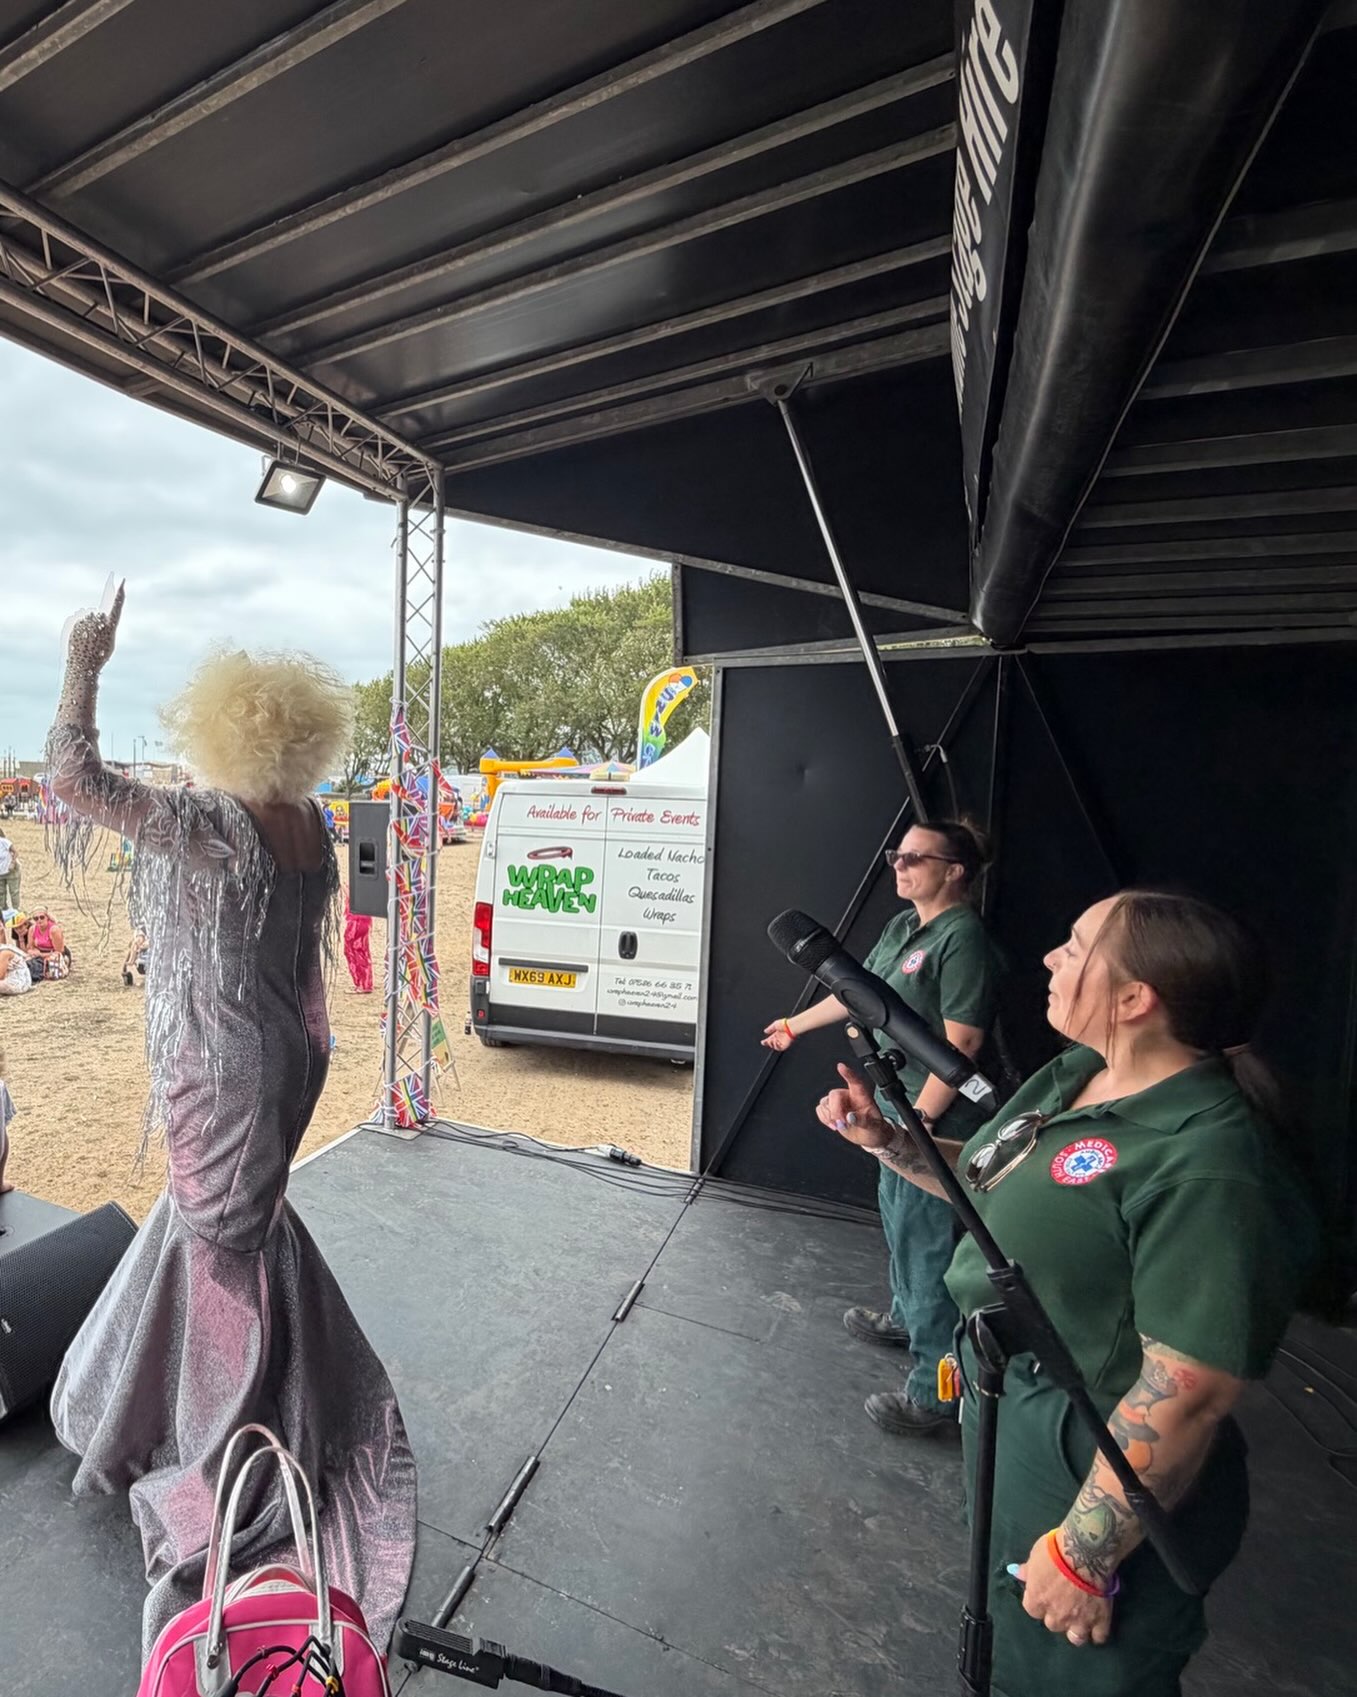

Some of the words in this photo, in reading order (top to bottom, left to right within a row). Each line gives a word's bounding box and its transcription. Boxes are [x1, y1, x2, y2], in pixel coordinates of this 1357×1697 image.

[959, 0, 1019, 205] Hire
[527, 804, 577, 820] Available
[581, 805, 602, 826] for
[610, 807, 655, 824] Private
[660, 810, 700, 827] Events
[618, 846, 665, 861] Loaded
[507, 864, 595, 893] WRAP
[647, 867, 681, 883] Tacos
[502, 887, 597, 914] HEAVEN
[628, 886, 696, 904] Quesadillas
[643, 907, 677, 925] Wraps
[514, 969, 545, 983] WX69
[548, 973, 572, 985] AXJ
